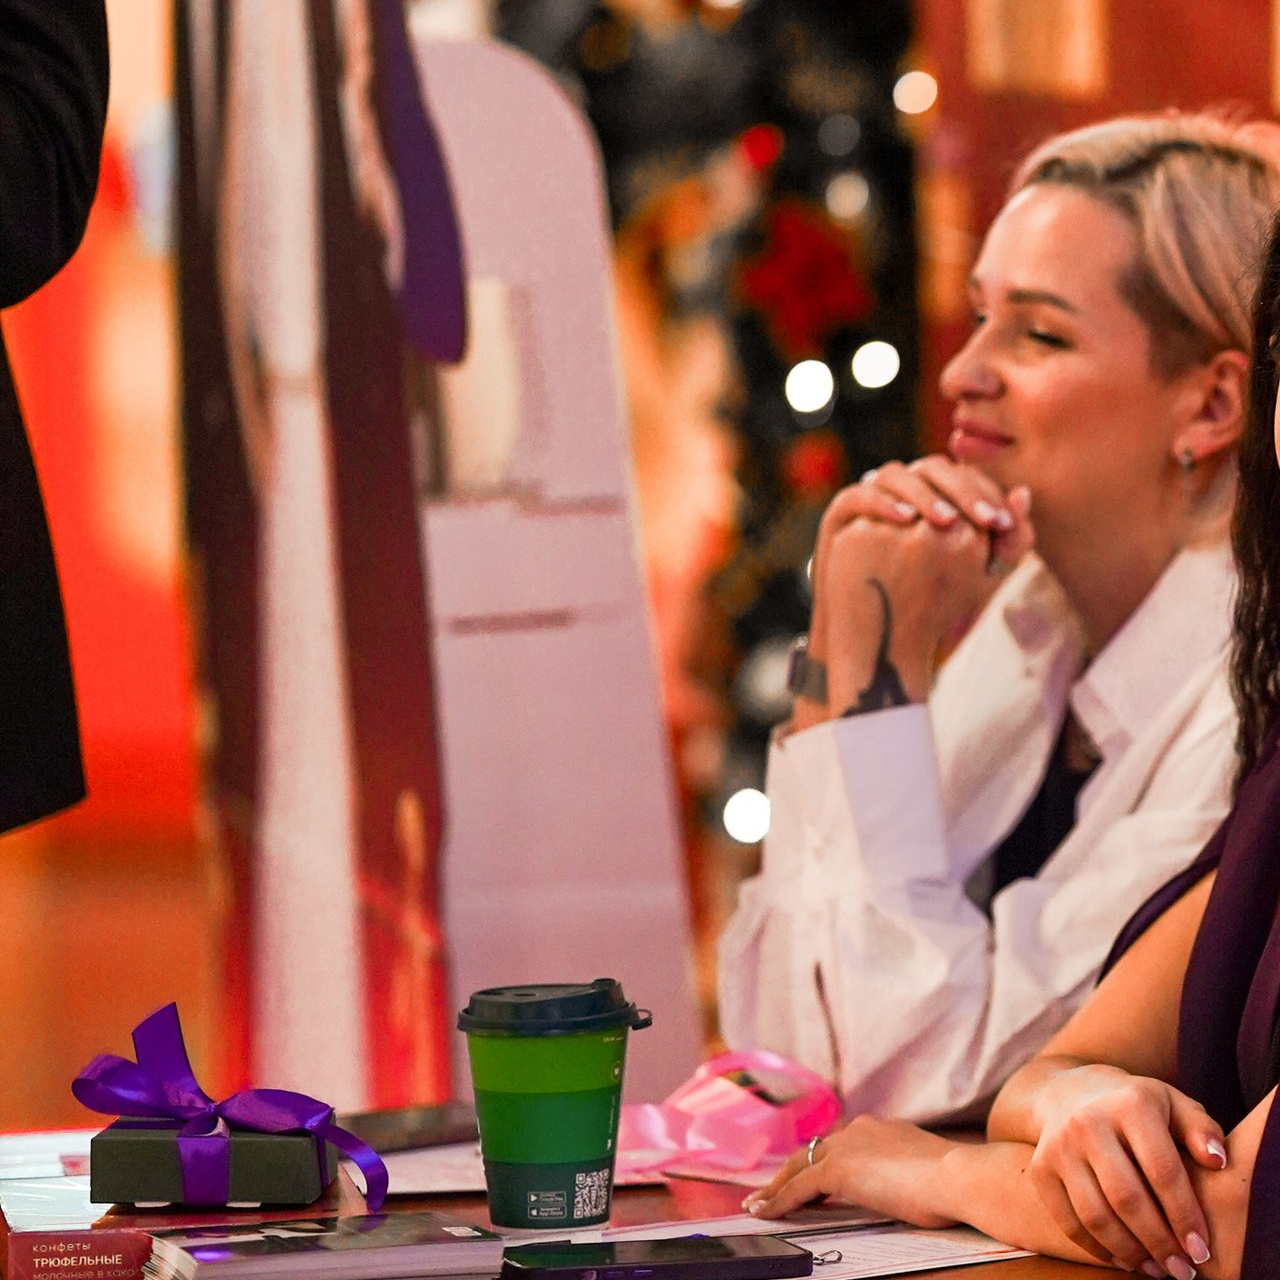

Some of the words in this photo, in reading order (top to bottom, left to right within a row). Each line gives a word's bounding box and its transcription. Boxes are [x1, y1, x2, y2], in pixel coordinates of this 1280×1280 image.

[32, 1242, 91, 1253] конфеты
[33, 1254, 123, 1268] ТРЮФЕЛЬНЫЕ
[33, 1270, 95, 1280] молочные
[106, 1269, 139, 1278] кака
